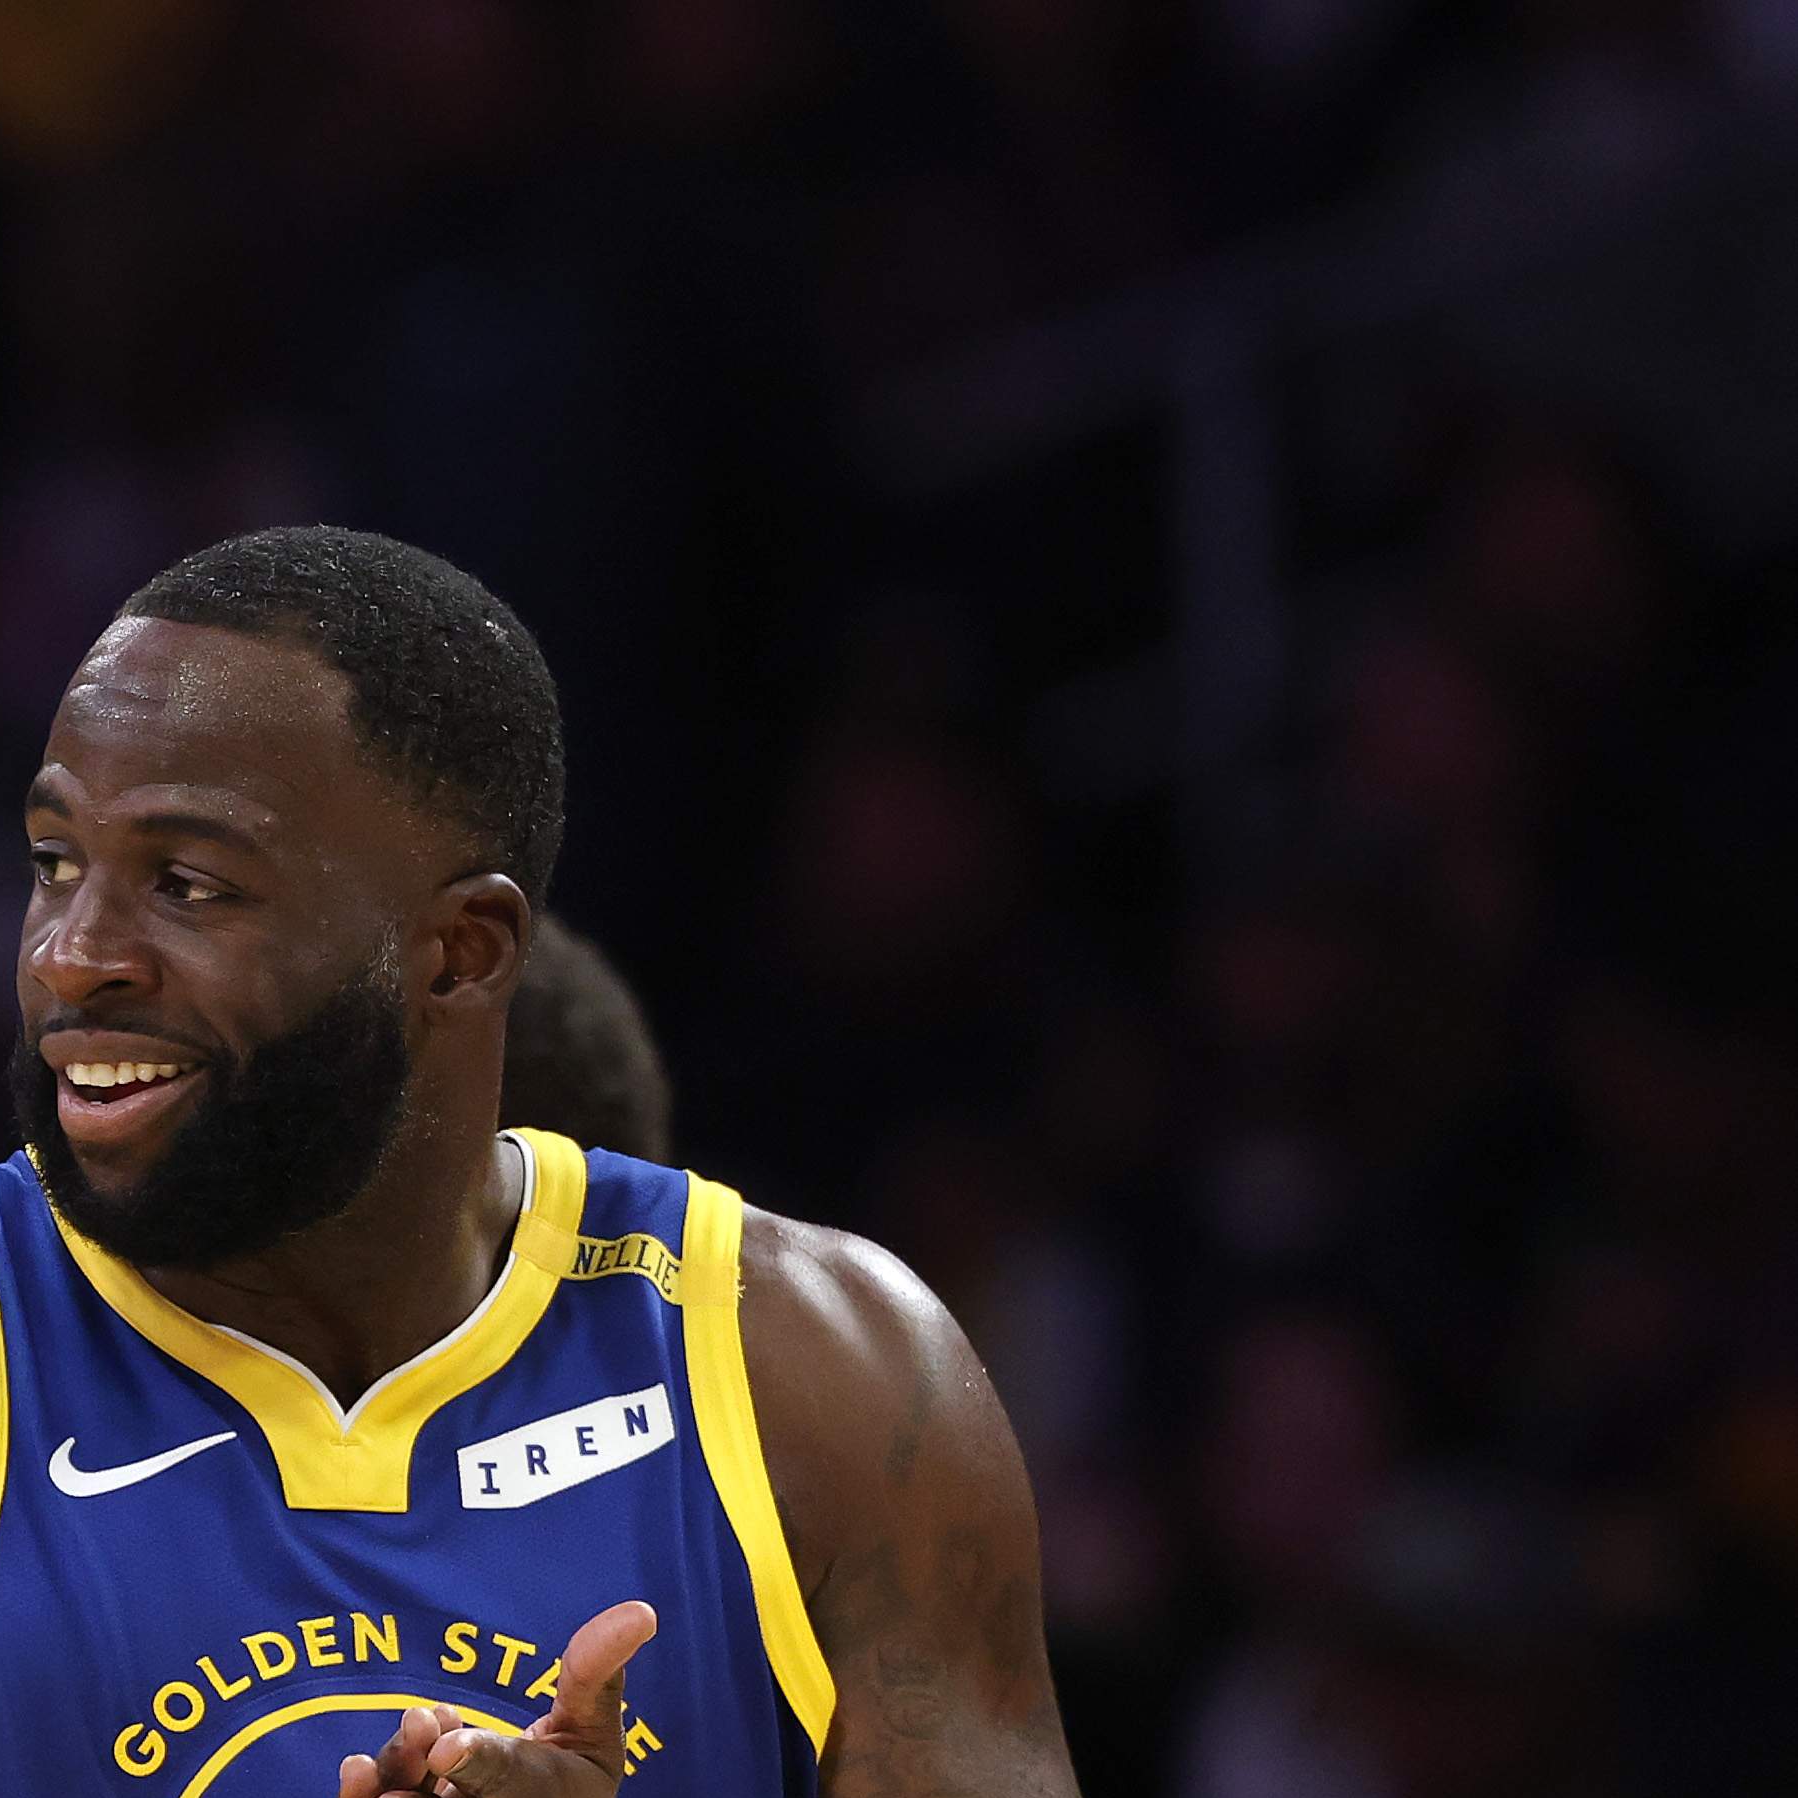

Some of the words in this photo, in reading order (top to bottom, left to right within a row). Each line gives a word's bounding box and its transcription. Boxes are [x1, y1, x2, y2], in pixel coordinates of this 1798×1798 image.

[571, 1240, 681, 1295] NELLIE
[477, 1404, 650, 1495] IREN
[113, 1612, 401, 1777] GOLDEN
[440, 1621, 665, 1777] STAE
